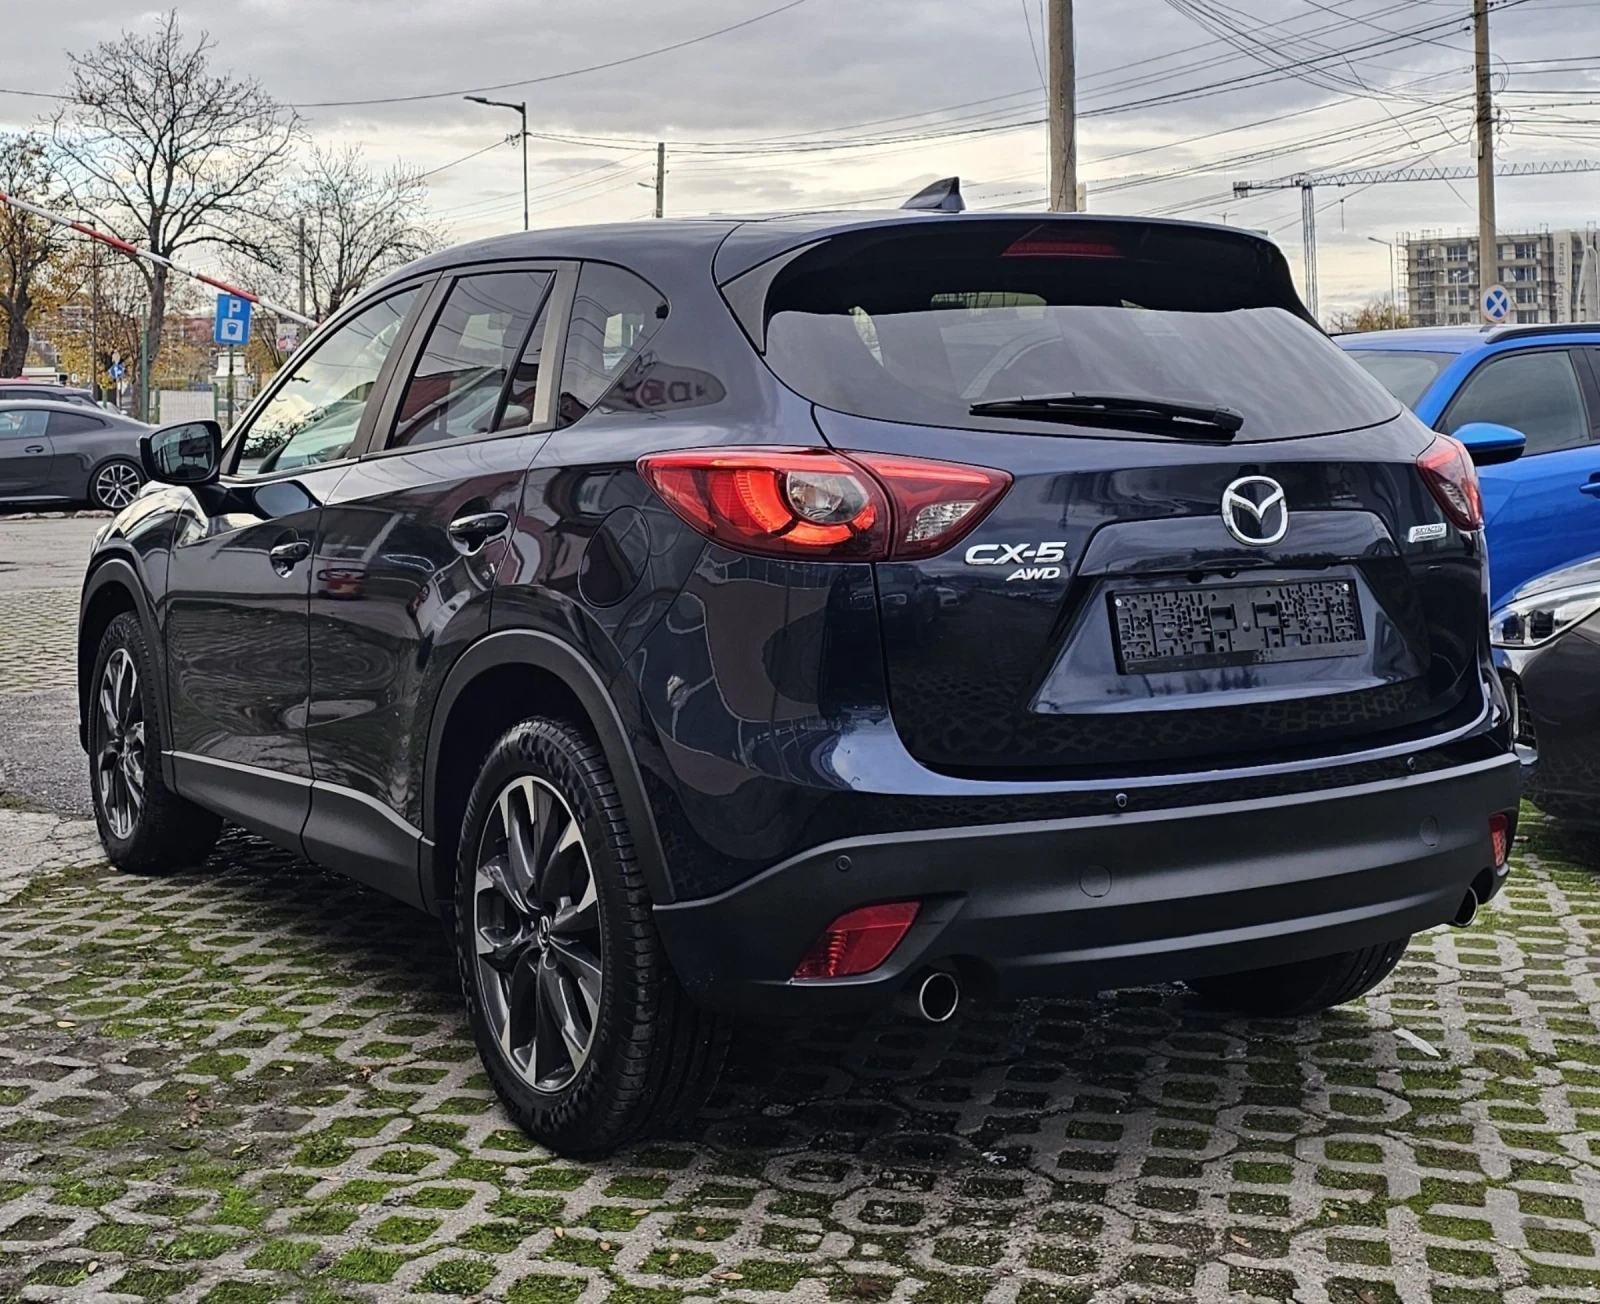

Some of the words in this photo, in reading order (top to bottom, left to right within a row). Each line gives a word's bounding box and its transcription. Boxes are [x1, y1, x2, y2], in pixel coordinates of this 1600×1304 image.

[228, 299, 241, 318] P
[965, 541, 1068, 565] CX-5
[1005, 567, 1061, 581] AWD
